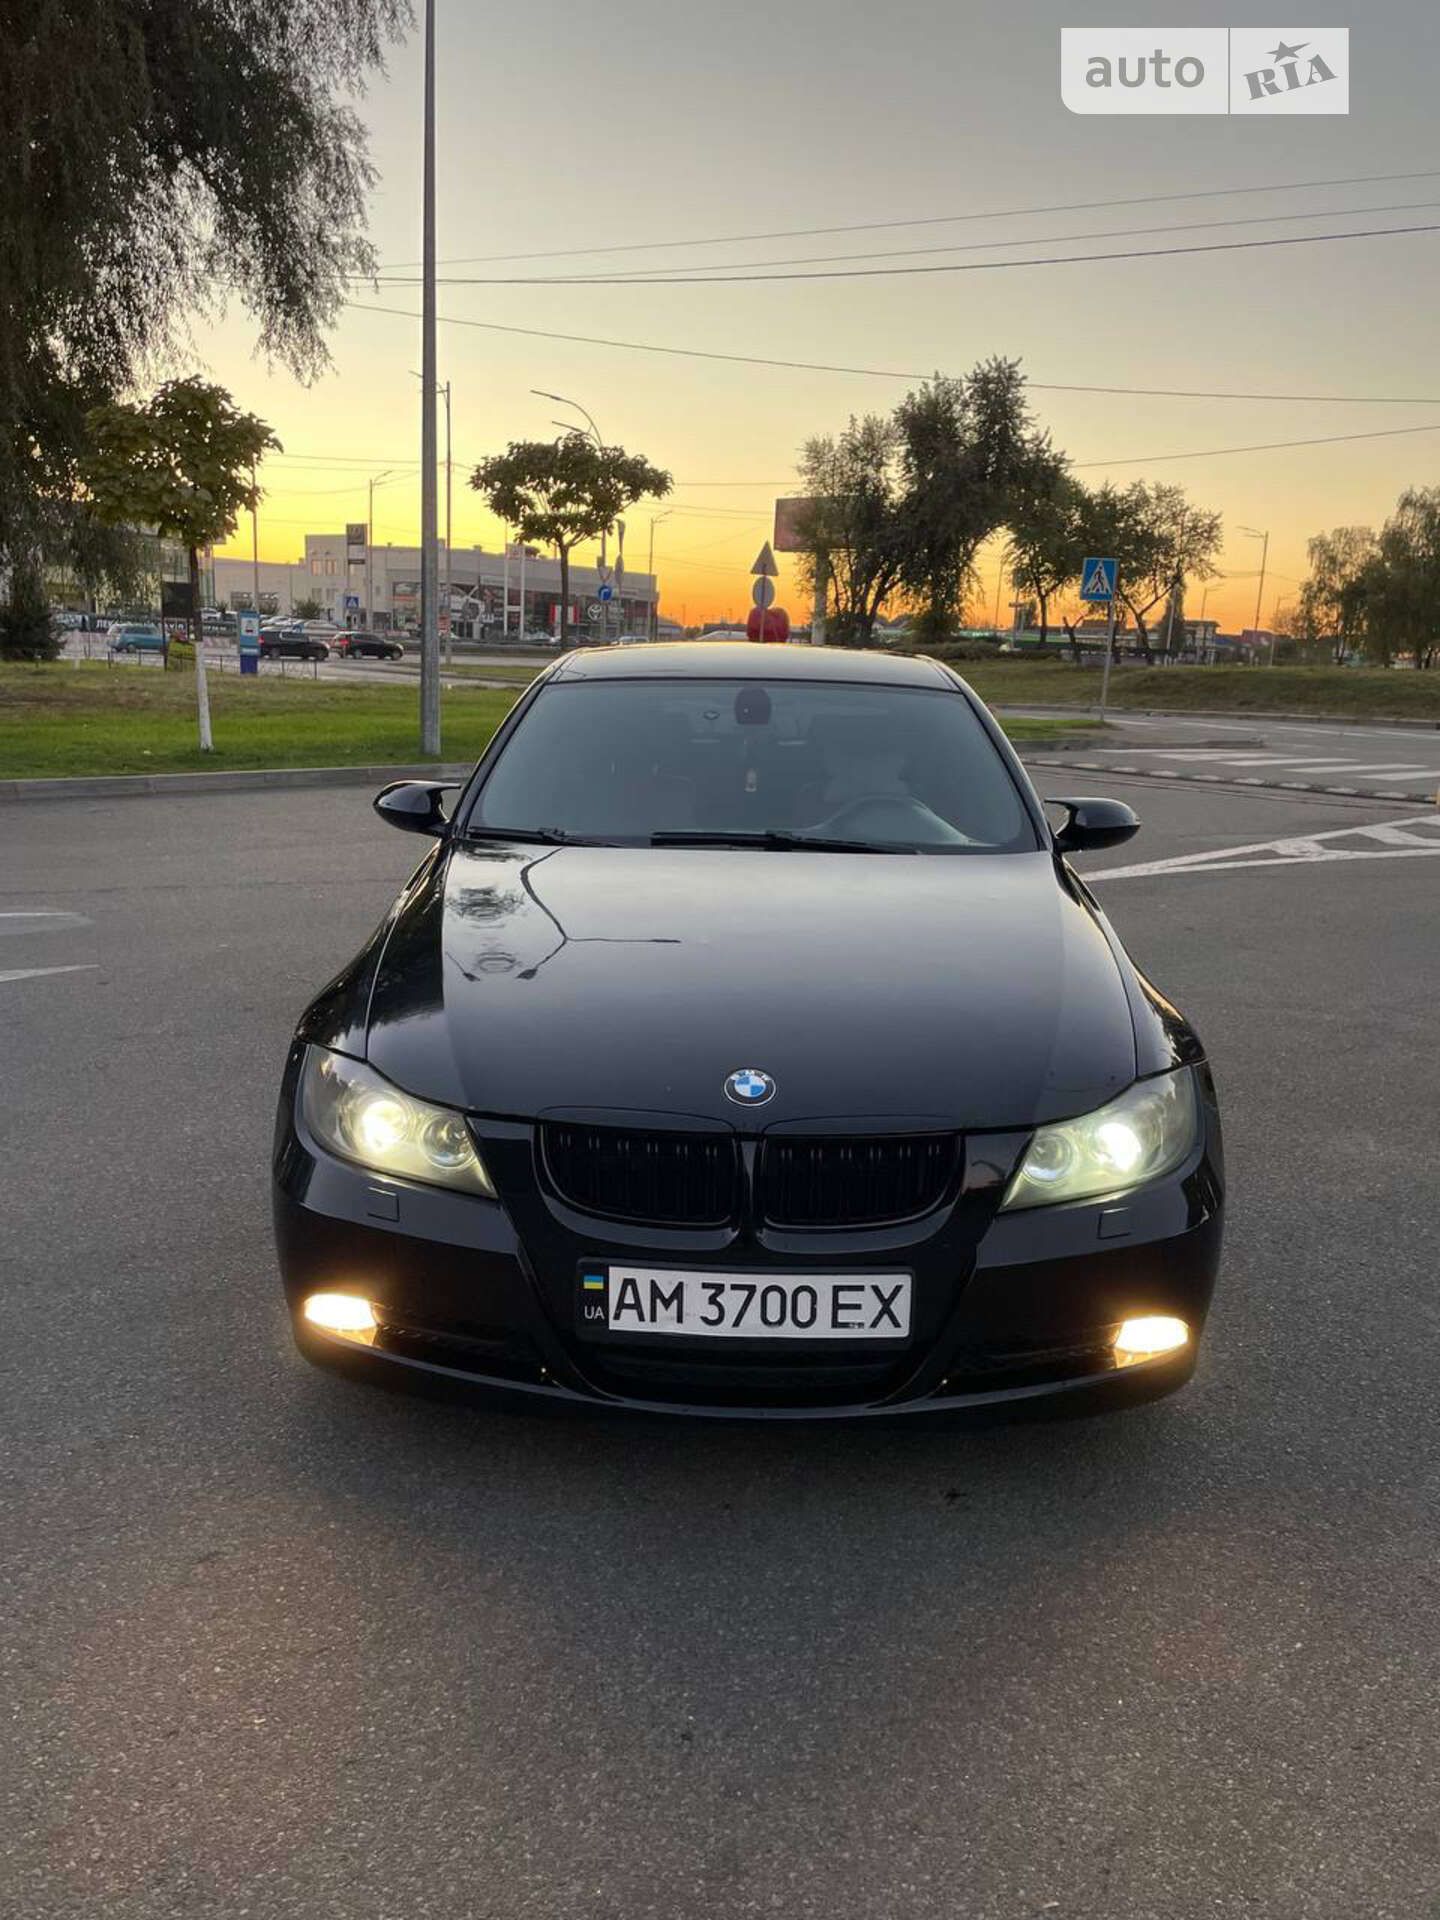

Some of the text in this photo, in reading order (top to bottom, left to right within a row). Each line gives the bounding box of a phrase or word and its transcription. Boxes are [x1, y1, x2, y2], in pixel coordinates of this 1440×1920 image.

[584, 1306, 605, 1320] UA
[613, 1277, 904, 1329] AM 3700 EX
